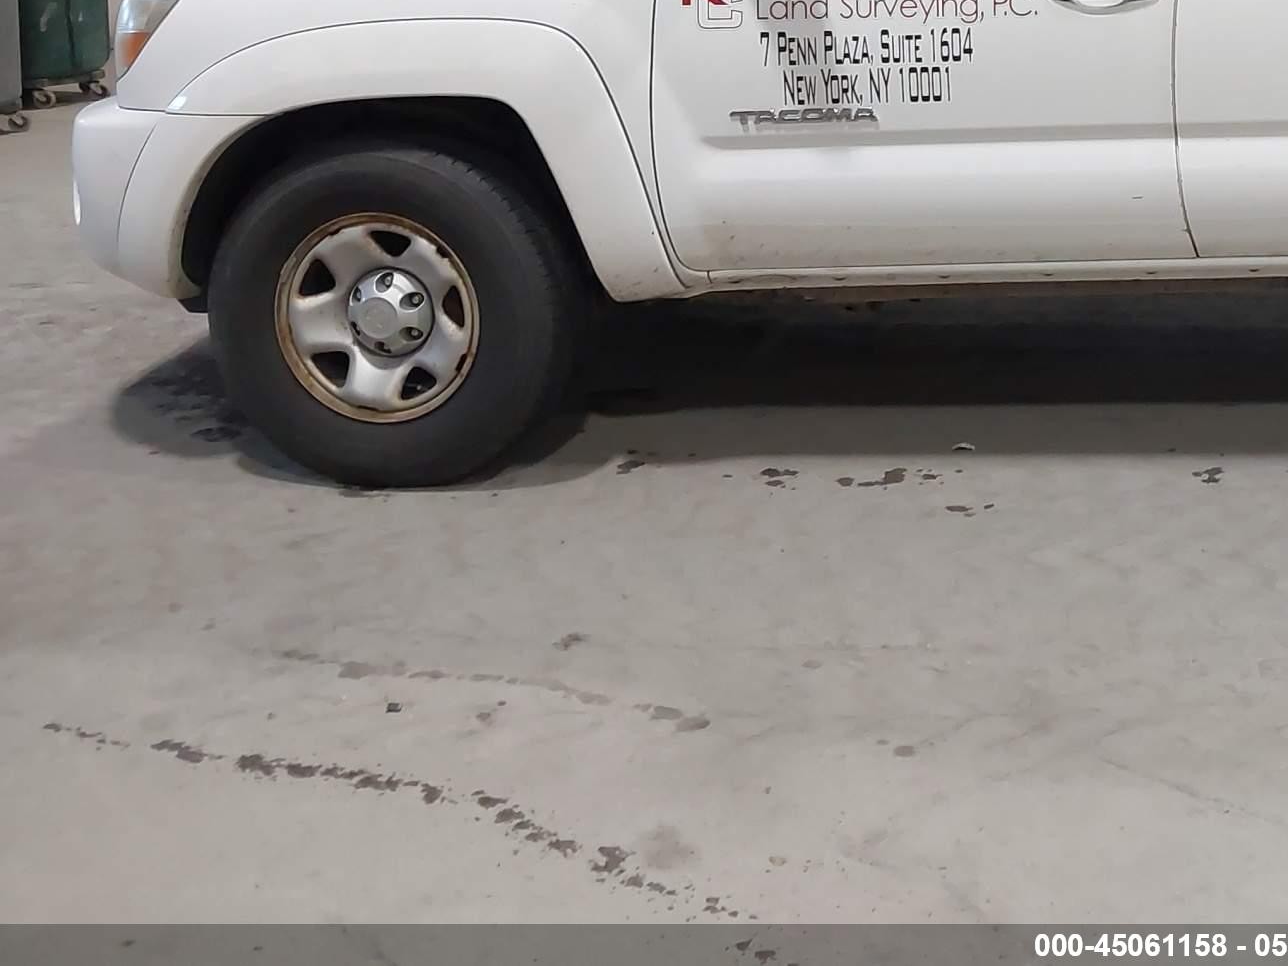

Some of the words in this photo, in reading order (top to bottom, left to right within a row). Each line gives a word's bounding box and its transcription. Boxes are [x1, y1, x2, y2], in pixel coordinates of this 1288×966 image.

[760, 32, 770, 67] 7
[930, 27, 974, 63] 1604
[869, 67, 891, 104] NY
[899, 66, 951, 103] 10001
[729, 107, 878, 129] TACOMA
